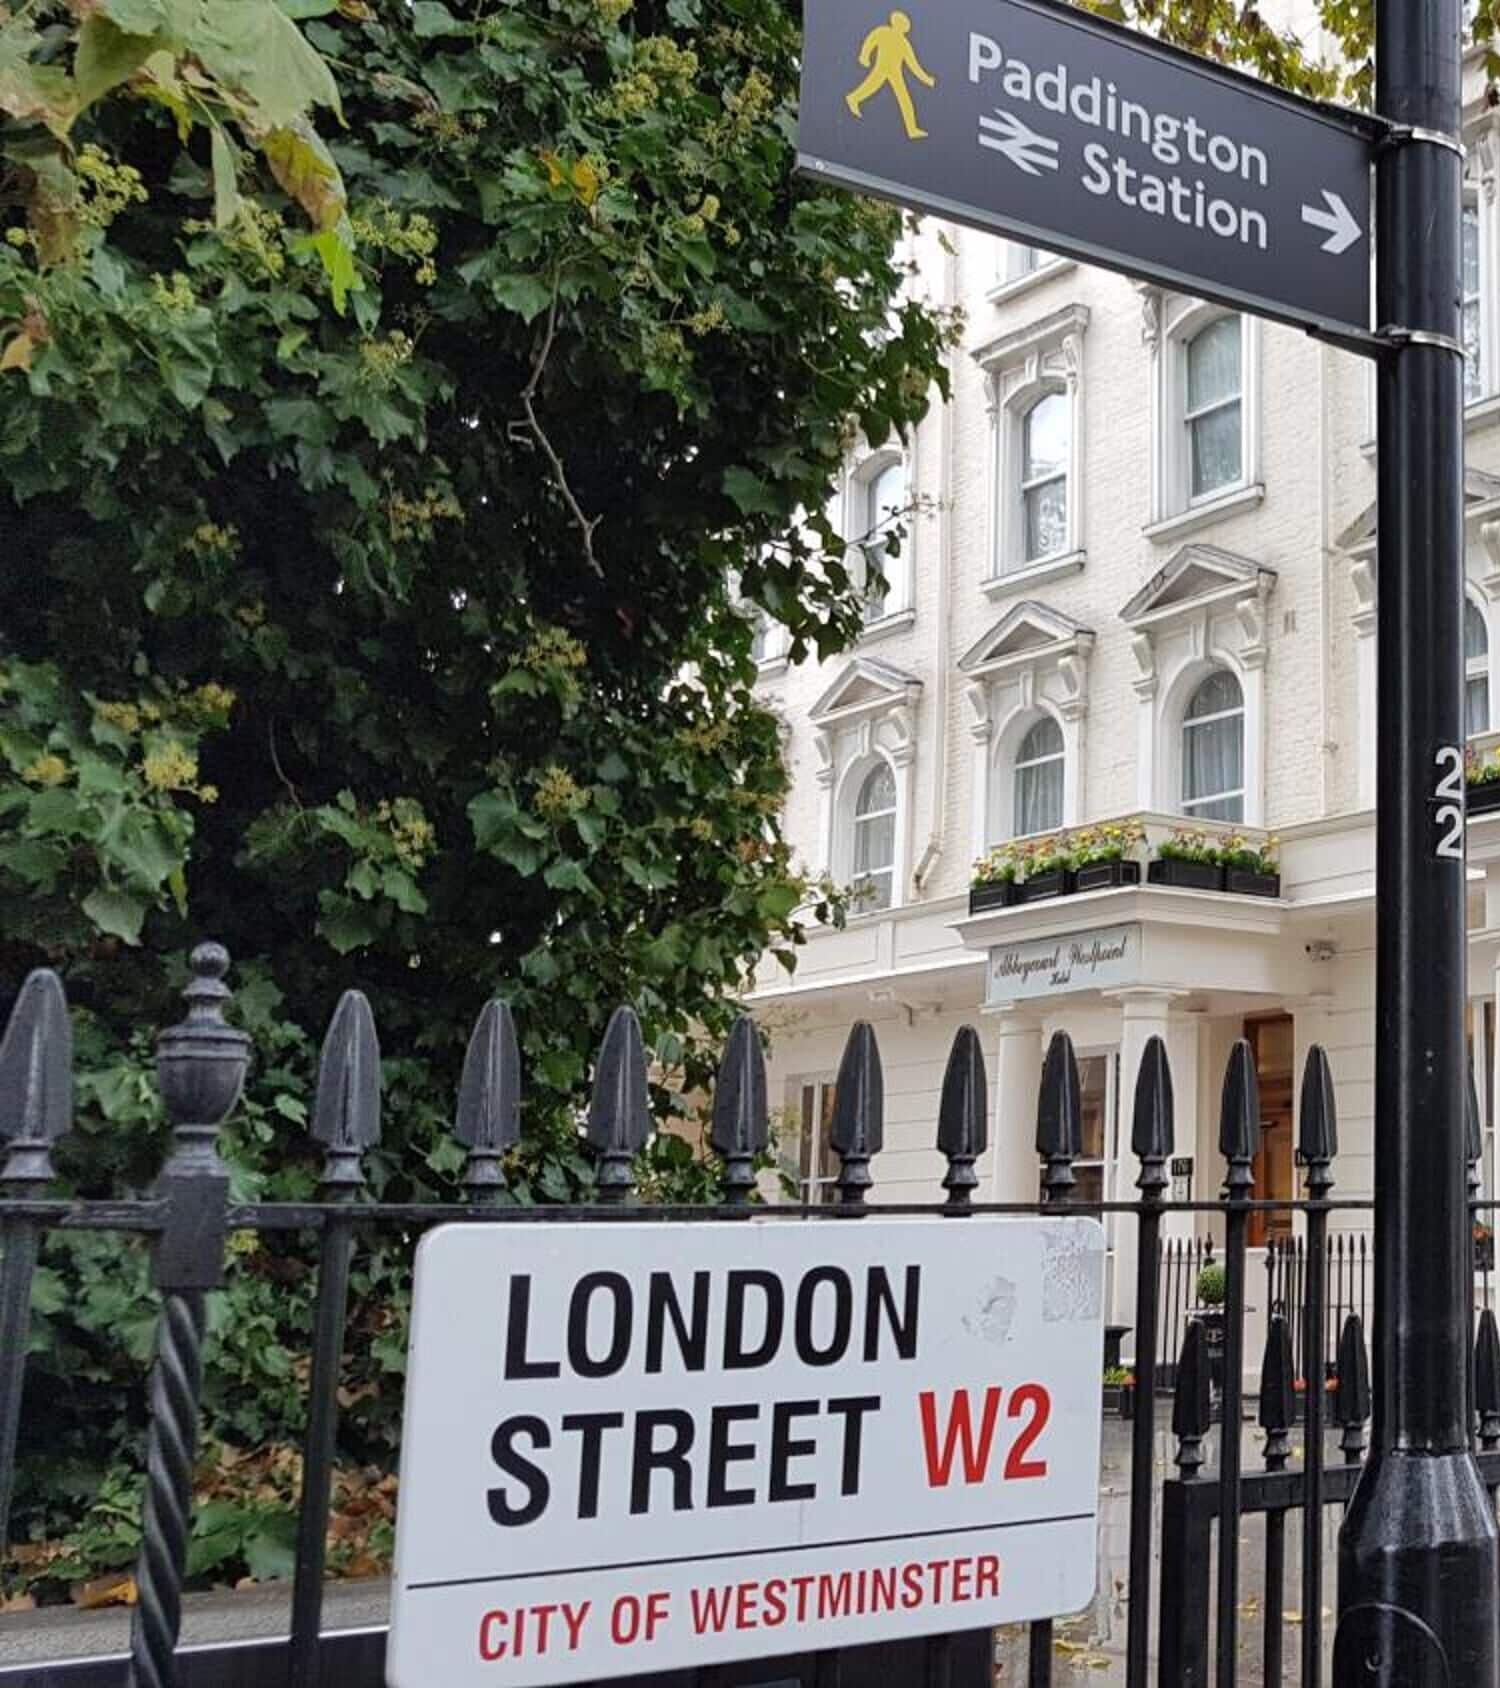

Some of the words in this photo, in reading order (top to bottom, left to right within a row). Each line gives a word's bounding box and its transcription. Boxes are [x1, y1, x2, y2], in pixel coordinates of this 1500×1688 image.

[968, 31, 1268, 186] Paddington
[1082, 142, 1268, 249] Station
[503, 1264, 921, 1380] LONDON
[486, 1395, 881, 1527] STREET
[919, 1383, 1051, 1488] W2
[478, 1601, 591, 1662] CITY
[610, 1593, 670, 1646] OF
[690, 1555, 1001, 1635] WESTMINSTER
